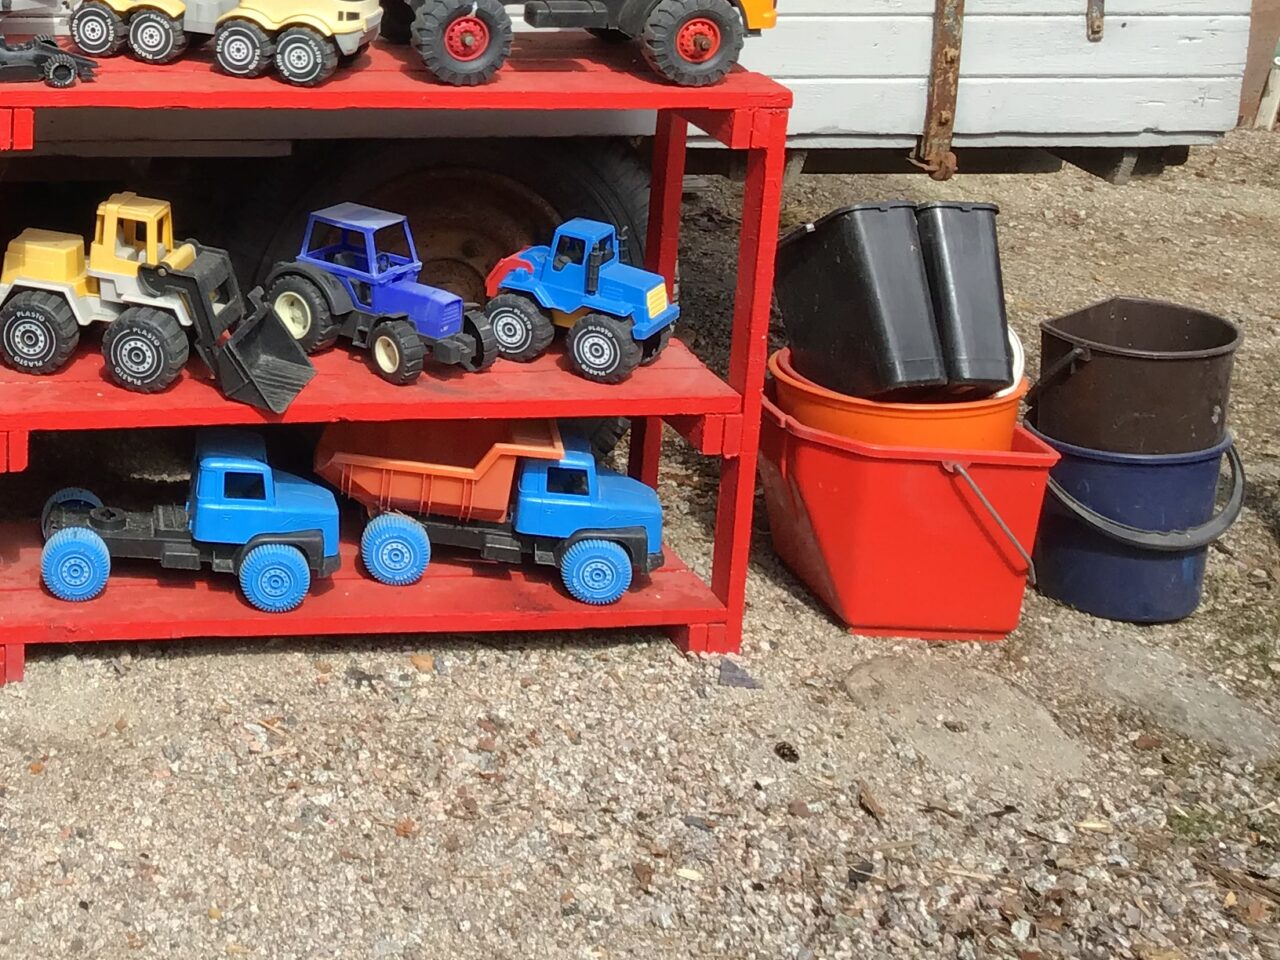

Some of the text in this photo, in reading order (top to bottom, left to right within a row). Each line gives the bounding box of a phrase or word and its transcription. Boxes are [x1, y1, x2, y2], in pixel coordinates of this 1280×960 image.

[16, 311, 45, 321] PLASTO
[133, 327, 160, 346] PLASTO
[14, 355, 43, 367] PLASTO
[115, 366, 142, 386] PLASTO
